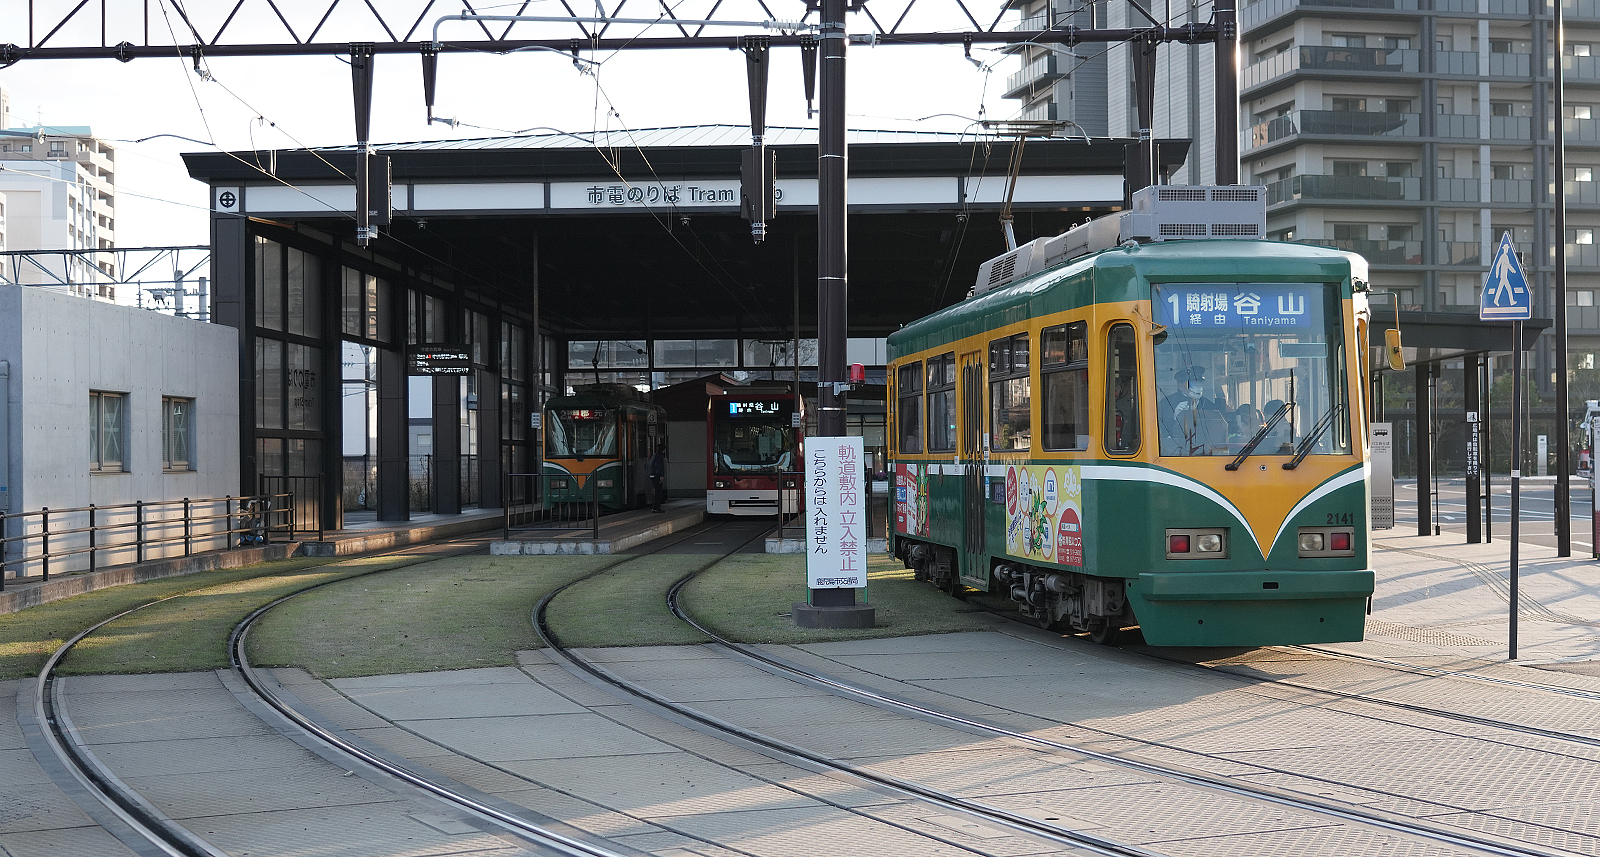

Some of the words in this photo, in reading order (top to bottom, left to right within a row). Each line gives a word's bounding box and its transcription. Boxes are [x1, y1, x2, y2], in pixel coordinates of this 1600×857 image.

[586, 185, 682, 205] 市電のりば
[687, 186, 734, 202] Tram
[1167, 293, 1180, 325] 1
[1186, 293, 1228, 312] 騎射場
[1244, 316, 1297, 326] Taniyama
[560, 410, 567, 420] 2
[1326, 512, 1354, 525] 2141
